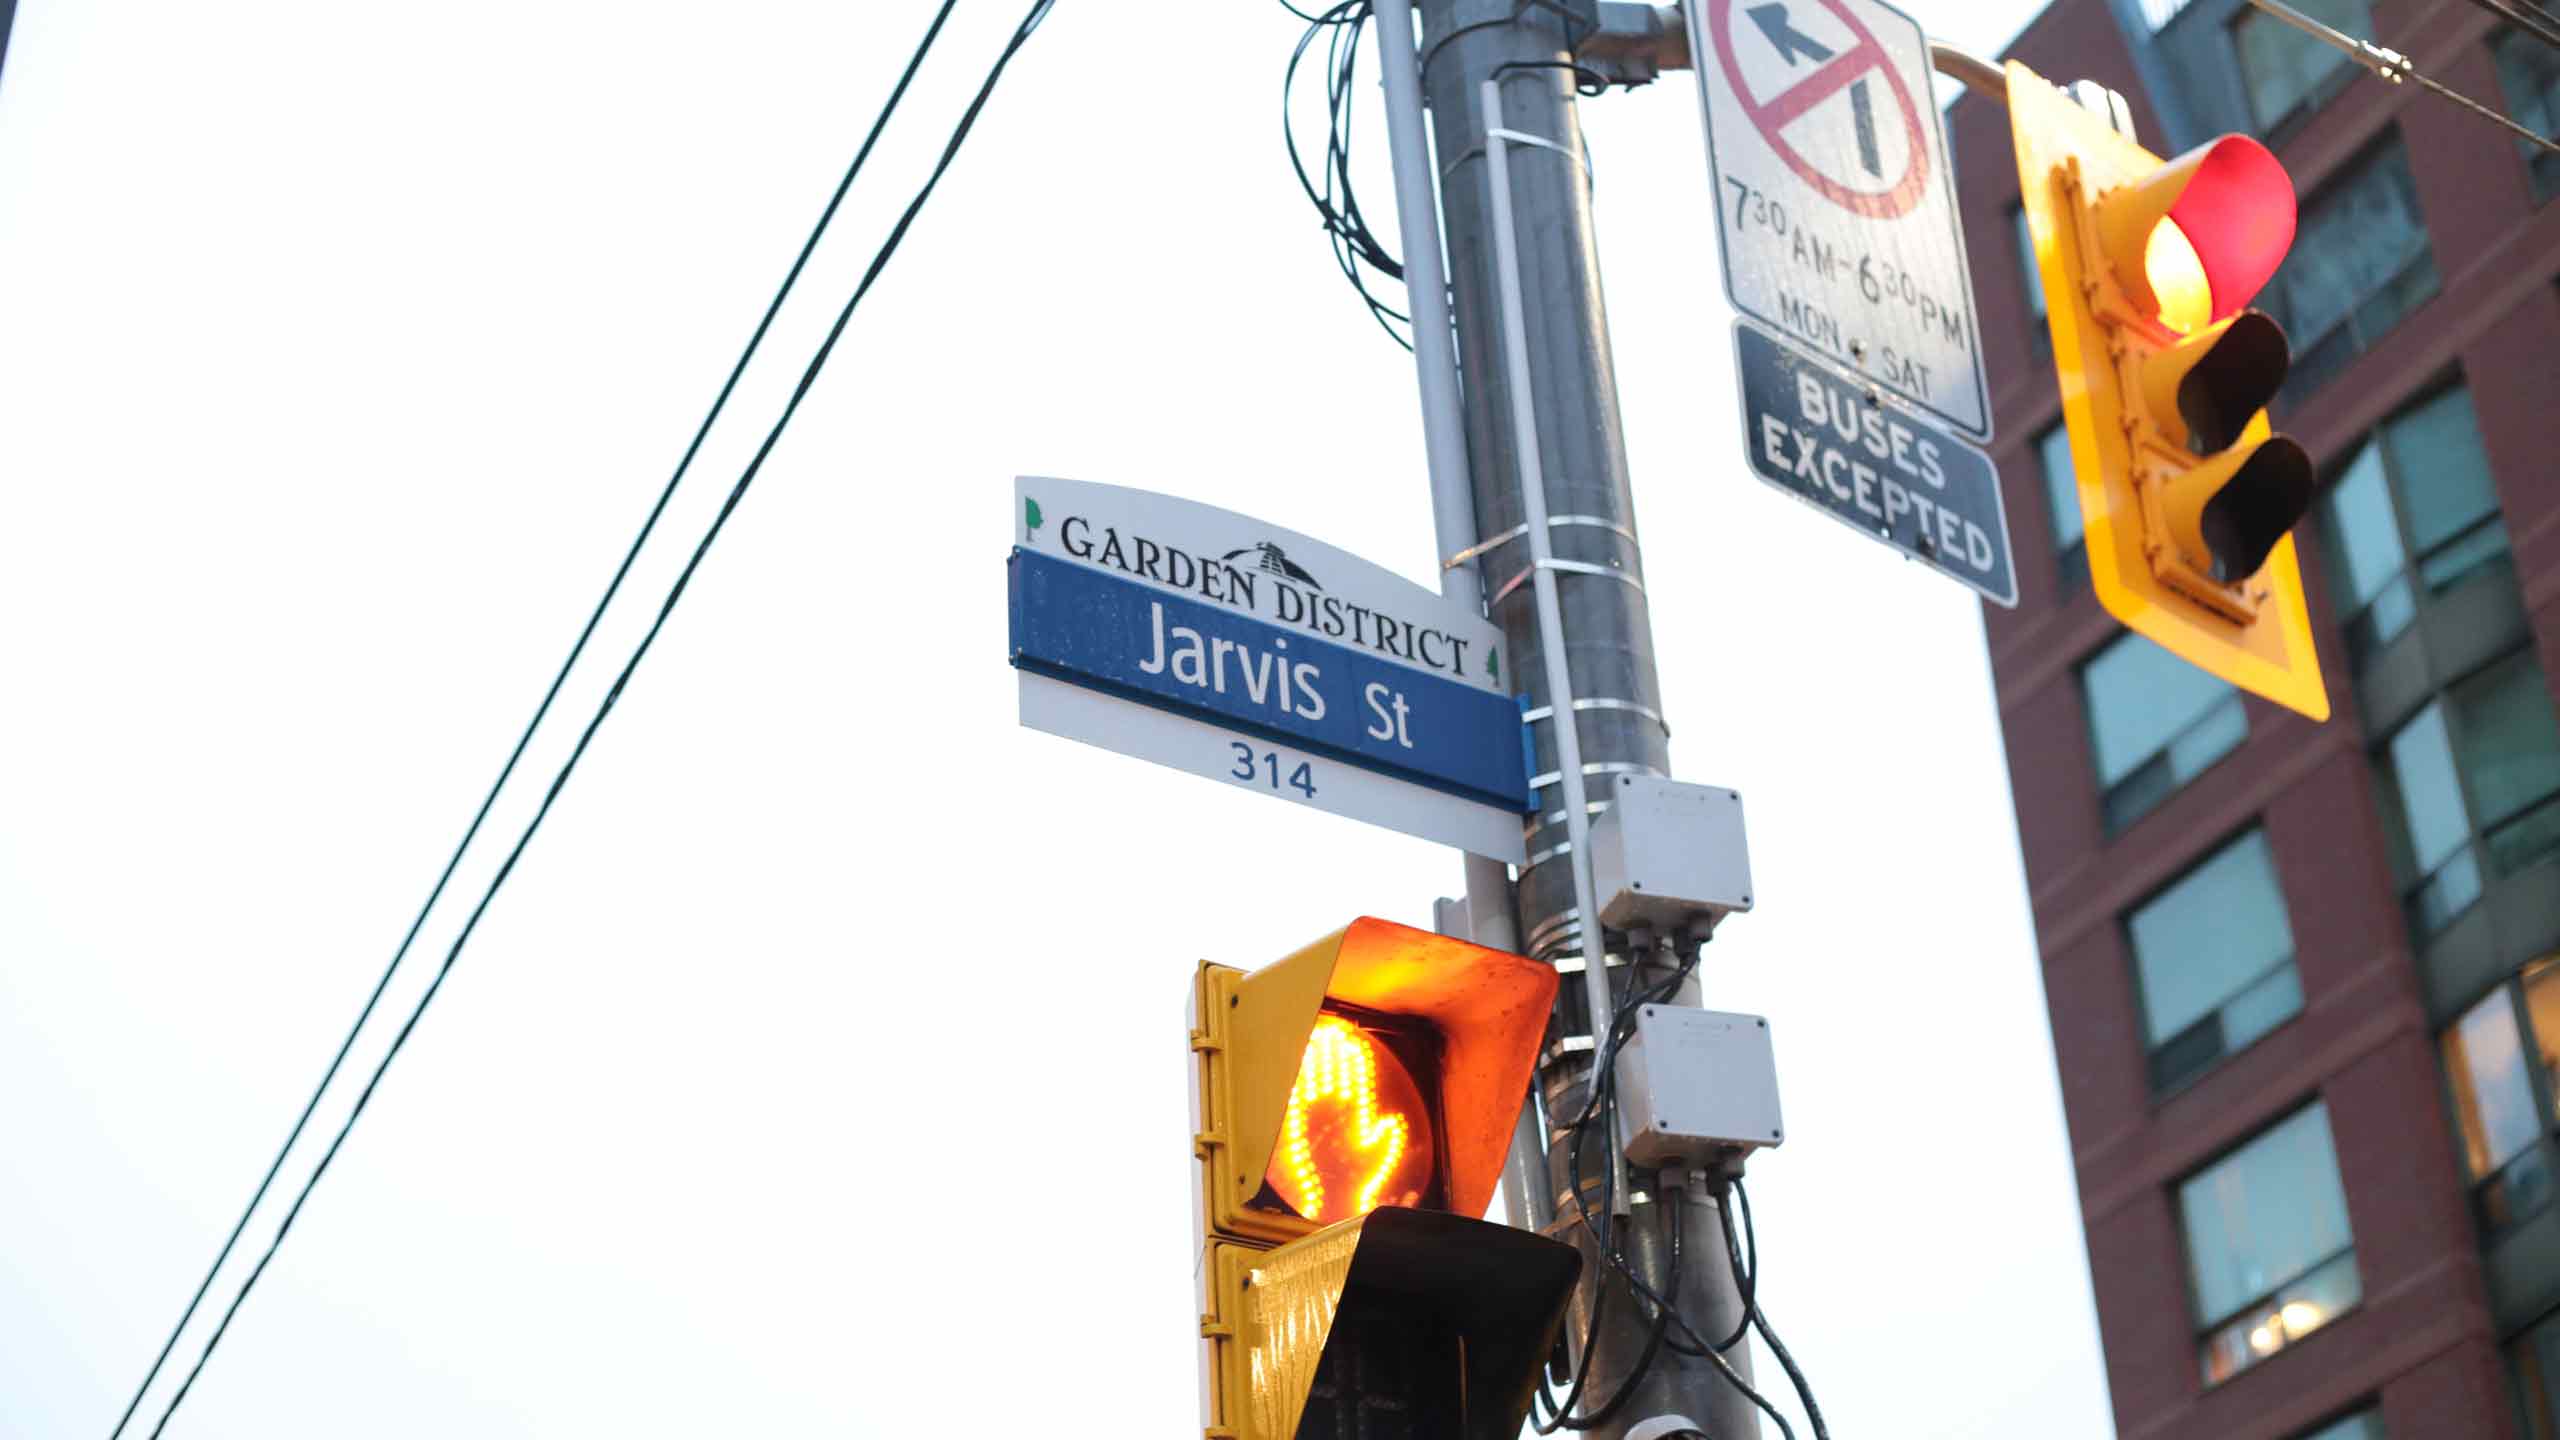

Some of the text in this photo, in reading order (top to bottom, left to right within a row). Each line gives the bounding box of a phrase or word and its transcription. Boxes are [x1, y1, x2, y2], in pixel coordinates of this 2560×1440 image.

[1778, 290, 1931, 400] MON SAT
[1761, 412, 1994, 573] EXCEPTED
[1796, 371, 1945, 490] BUSES
[1060, 516, 1469, 677] GARDEN DISTRICT
[1139, 600, 1413, 749] Jarvis St
[1230, 742, 1318, 800] 314
